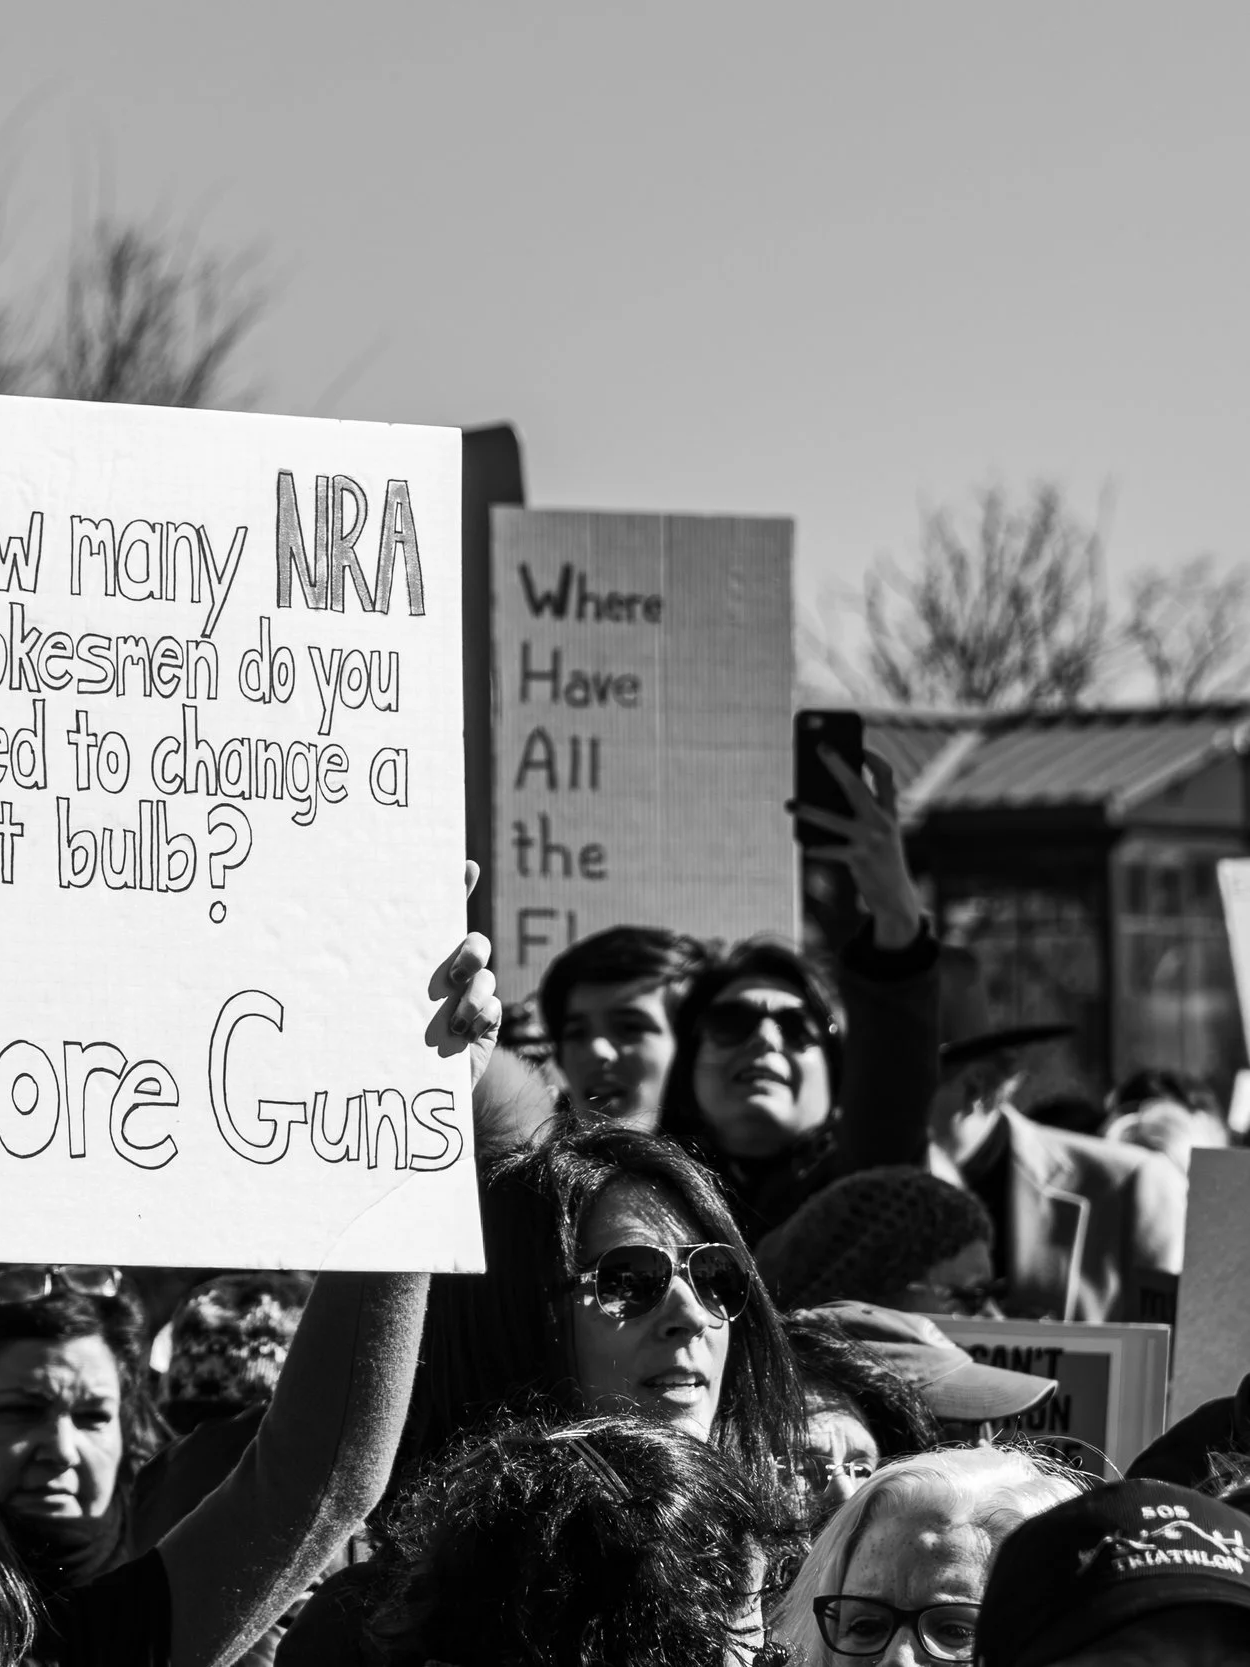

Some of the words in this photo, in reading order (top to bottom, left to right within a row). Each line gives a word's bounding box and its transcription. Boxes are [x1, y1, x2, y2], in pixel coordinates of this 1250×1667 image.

[69, 515, 248, 639] many
[276, 469, 426, 616] NRA
[518, 561, 663, 624] Where
[238, 616, 295, 704] do
[315, 646, 399, 736] you
[520, 641, 642, 709] Have
[67, 709, 130, 794] to
[151, 705, 350, 826] change
[368, 747, 409, 807] a
[515, 726, 601, 793] All
[56, 797, 254, 925] bulb?
[512, 813, 607, 881] the
[208, 988, 464, 1173] Guns
[1111, 1549, 1244, 1575] TRIATHLON
